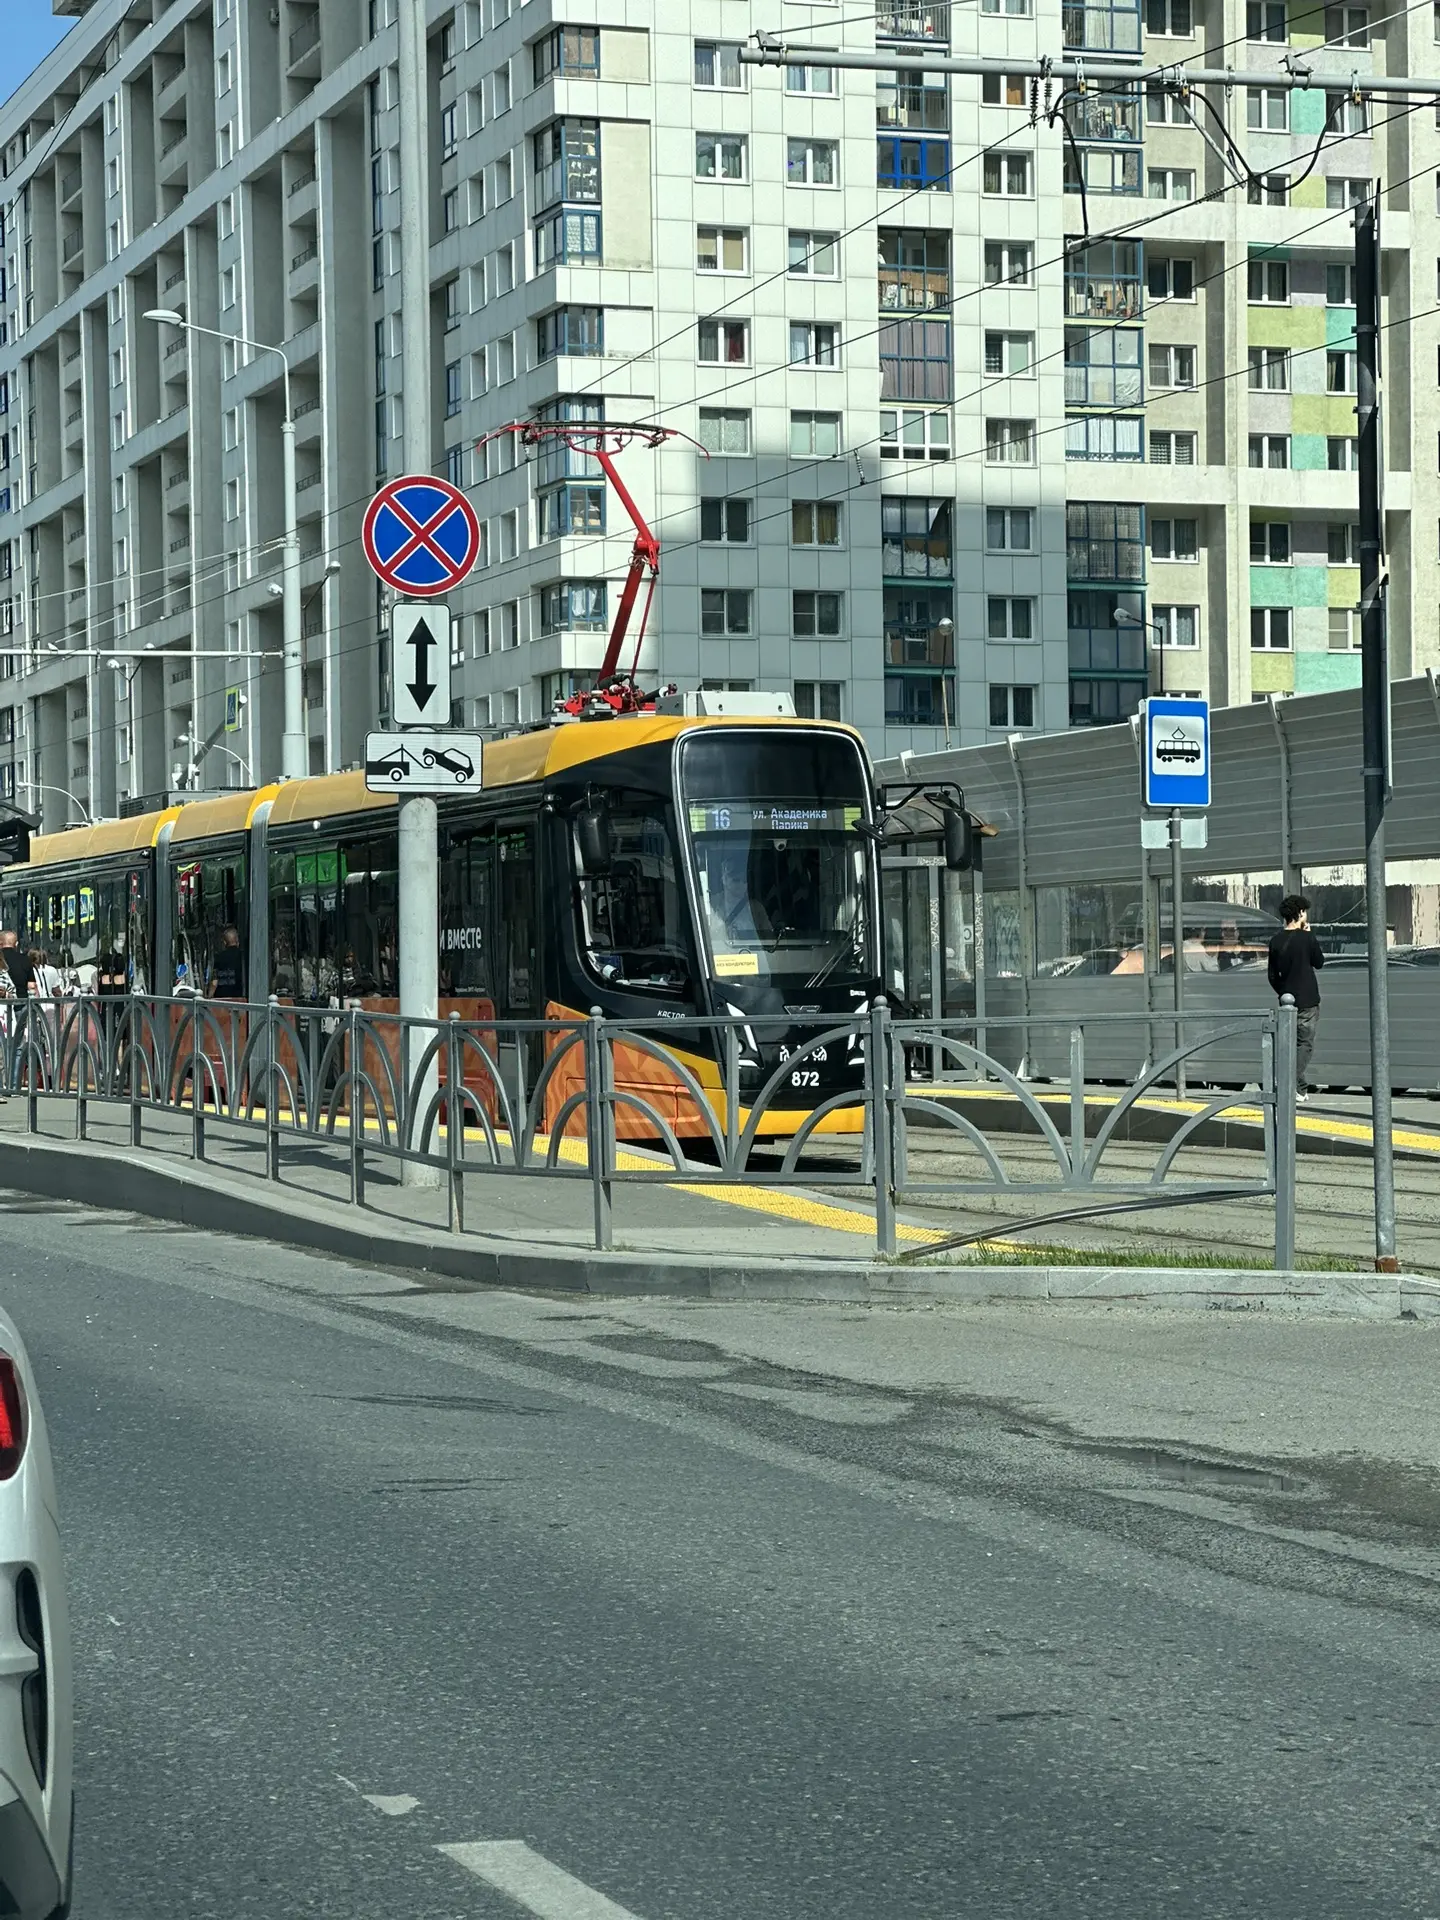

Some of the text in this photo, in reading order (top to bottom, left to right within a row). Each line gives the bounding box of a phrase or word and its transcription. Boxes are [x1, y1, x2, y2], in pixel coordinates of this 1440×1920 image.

[711, 809, 731, 830] 16
[752, 808, 827, 820] ул. Академика
[447, 927, 482, 950] вместе
[791, 1071, 820, 1087] 872
